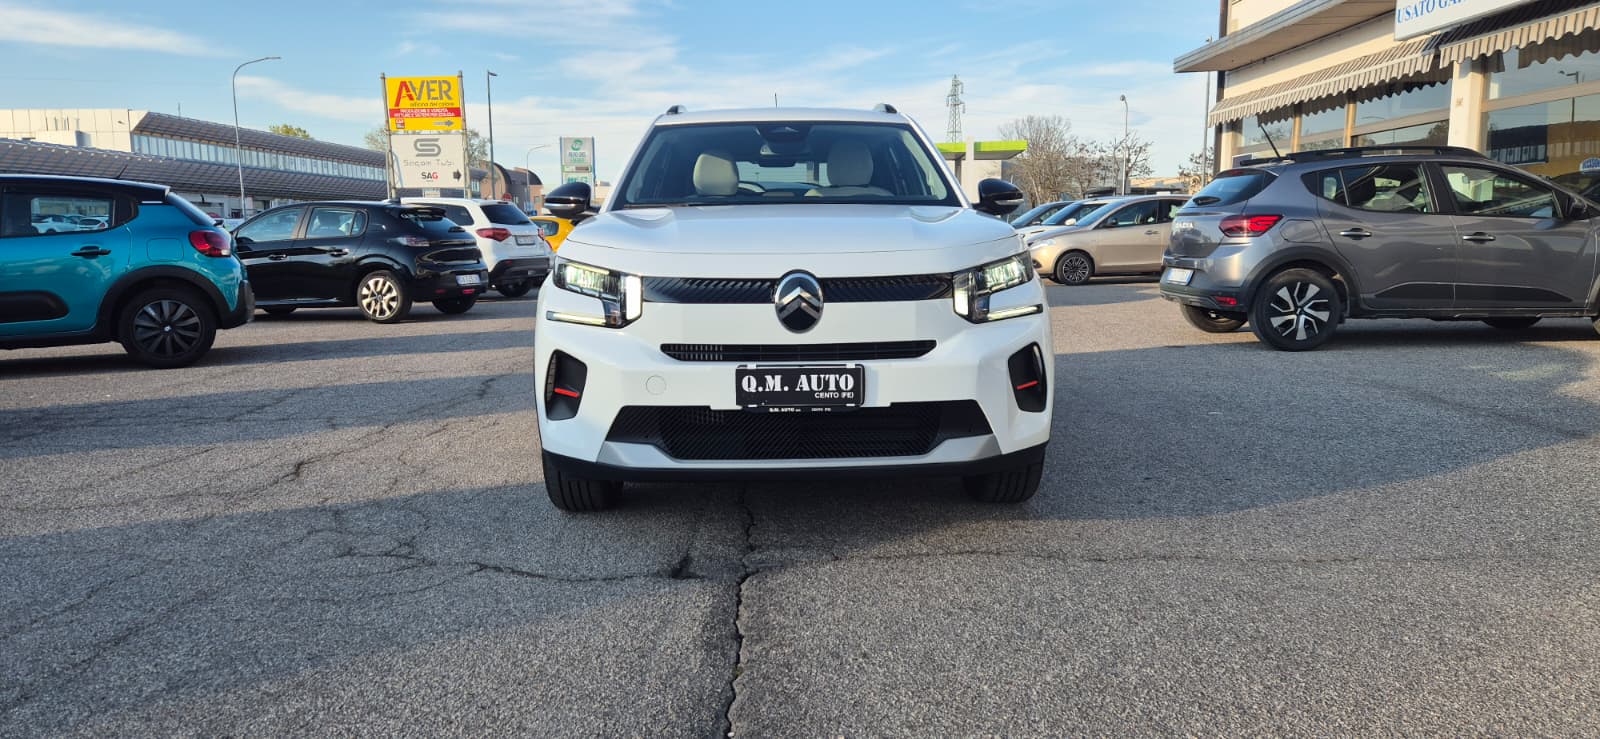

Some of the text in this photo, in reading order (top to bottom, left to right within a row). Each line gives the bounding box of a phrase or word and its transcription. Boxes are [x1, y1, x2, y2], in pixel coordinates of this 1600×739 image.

[1397, 0, 1436, 24] USATO
[394, 80, 453, 107] AVER
[741, 374, 854, 393] Q.M. AUTO
